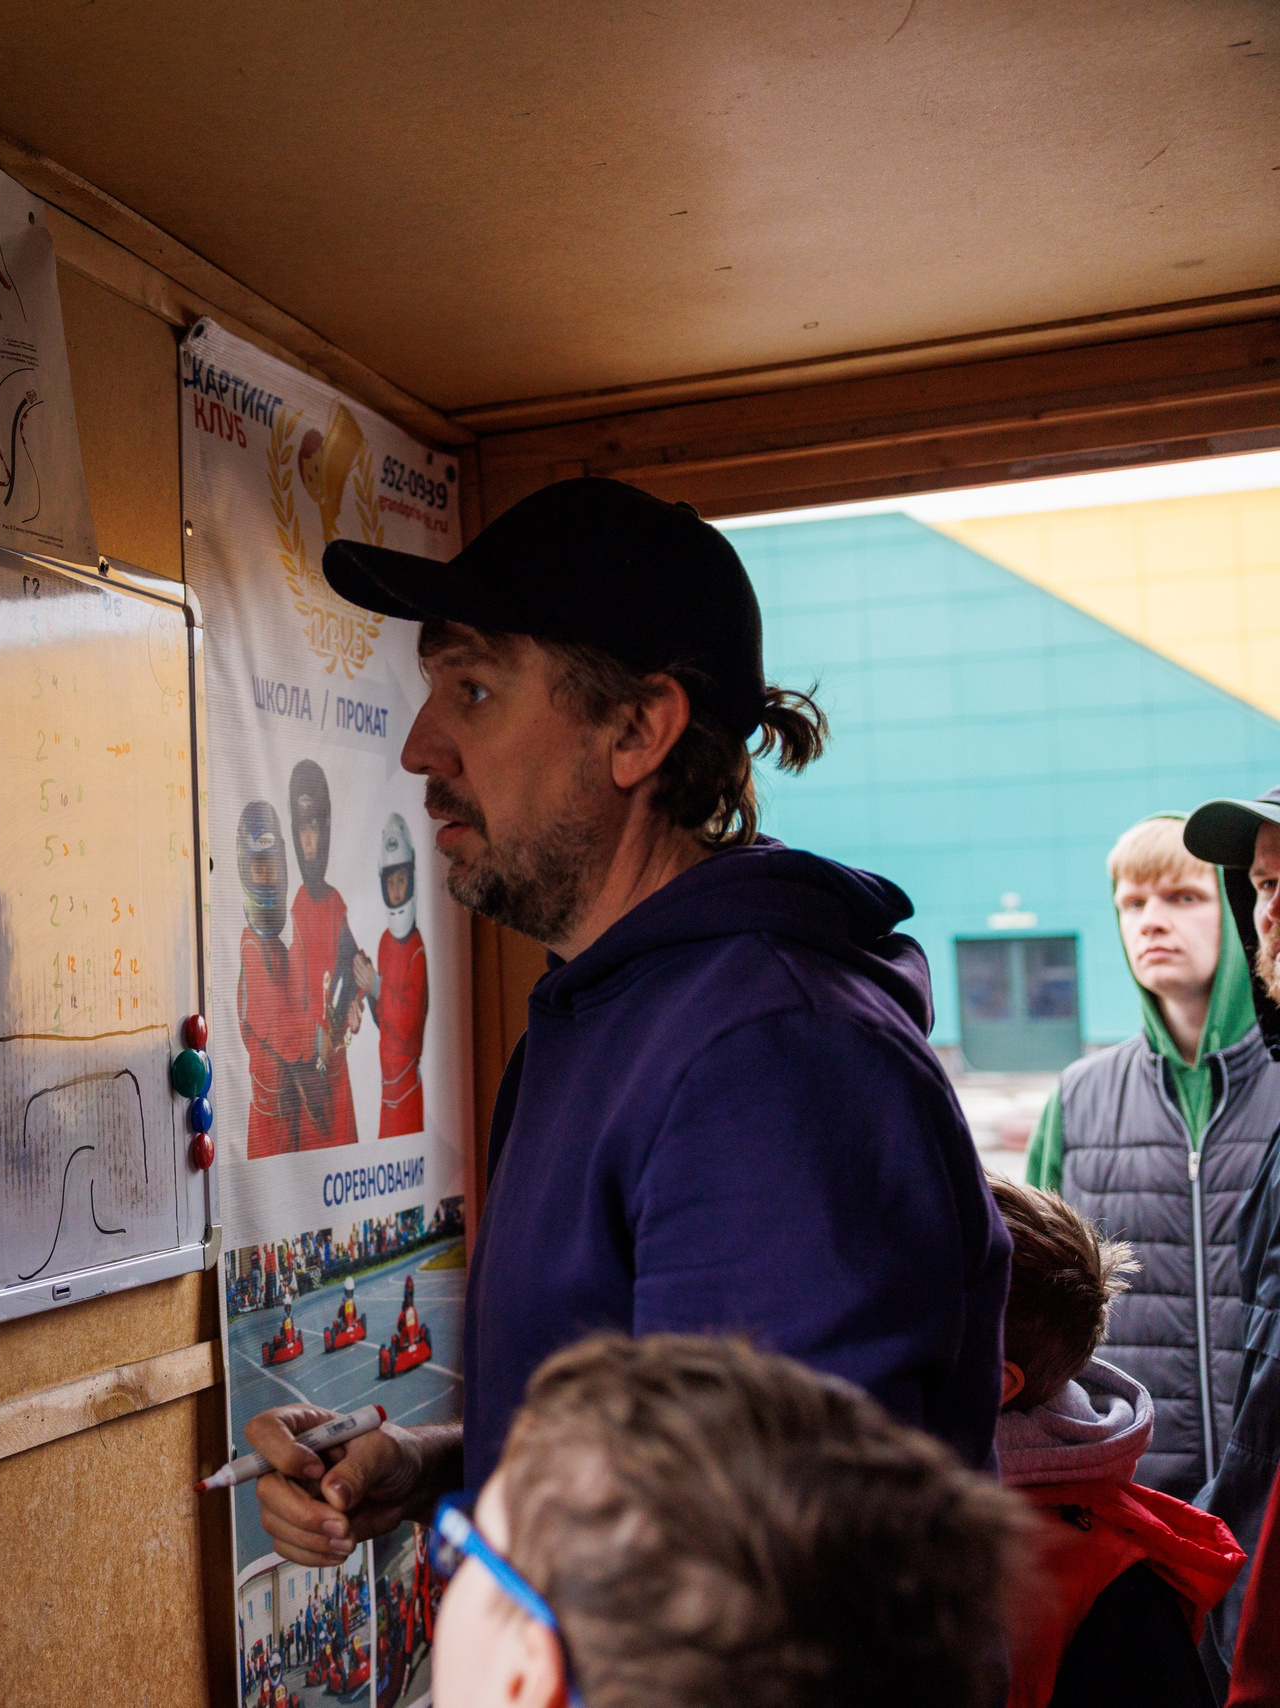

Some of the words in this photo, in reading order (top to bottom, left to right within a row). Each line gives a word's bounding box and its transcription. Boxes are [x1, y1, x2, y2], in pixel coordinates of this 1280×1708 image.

[192, 355, 283, 429] КАРТИНГ
[194, 393, 247, 449] КЛУБ
[380, 454, 448, 510] 952-0939
[251, 675, 313, 721] ШКОЛА
[336, 696, 388, 738] ПРОКАТ
[35, 729, 48, 762] 2
[43, 835, 59, 867] 5
[50, 894, 61, 927] 2
[111, 897, 121, 923] 3
[52, 951, 63, 988] 1
[112, 948, 122, 976] 2
[130, 958, 140, 975] 12
[52, 1003, 65, 1032] 1
[323, 1156, 425, 1207] СОРЕВНОВАНИЯ
